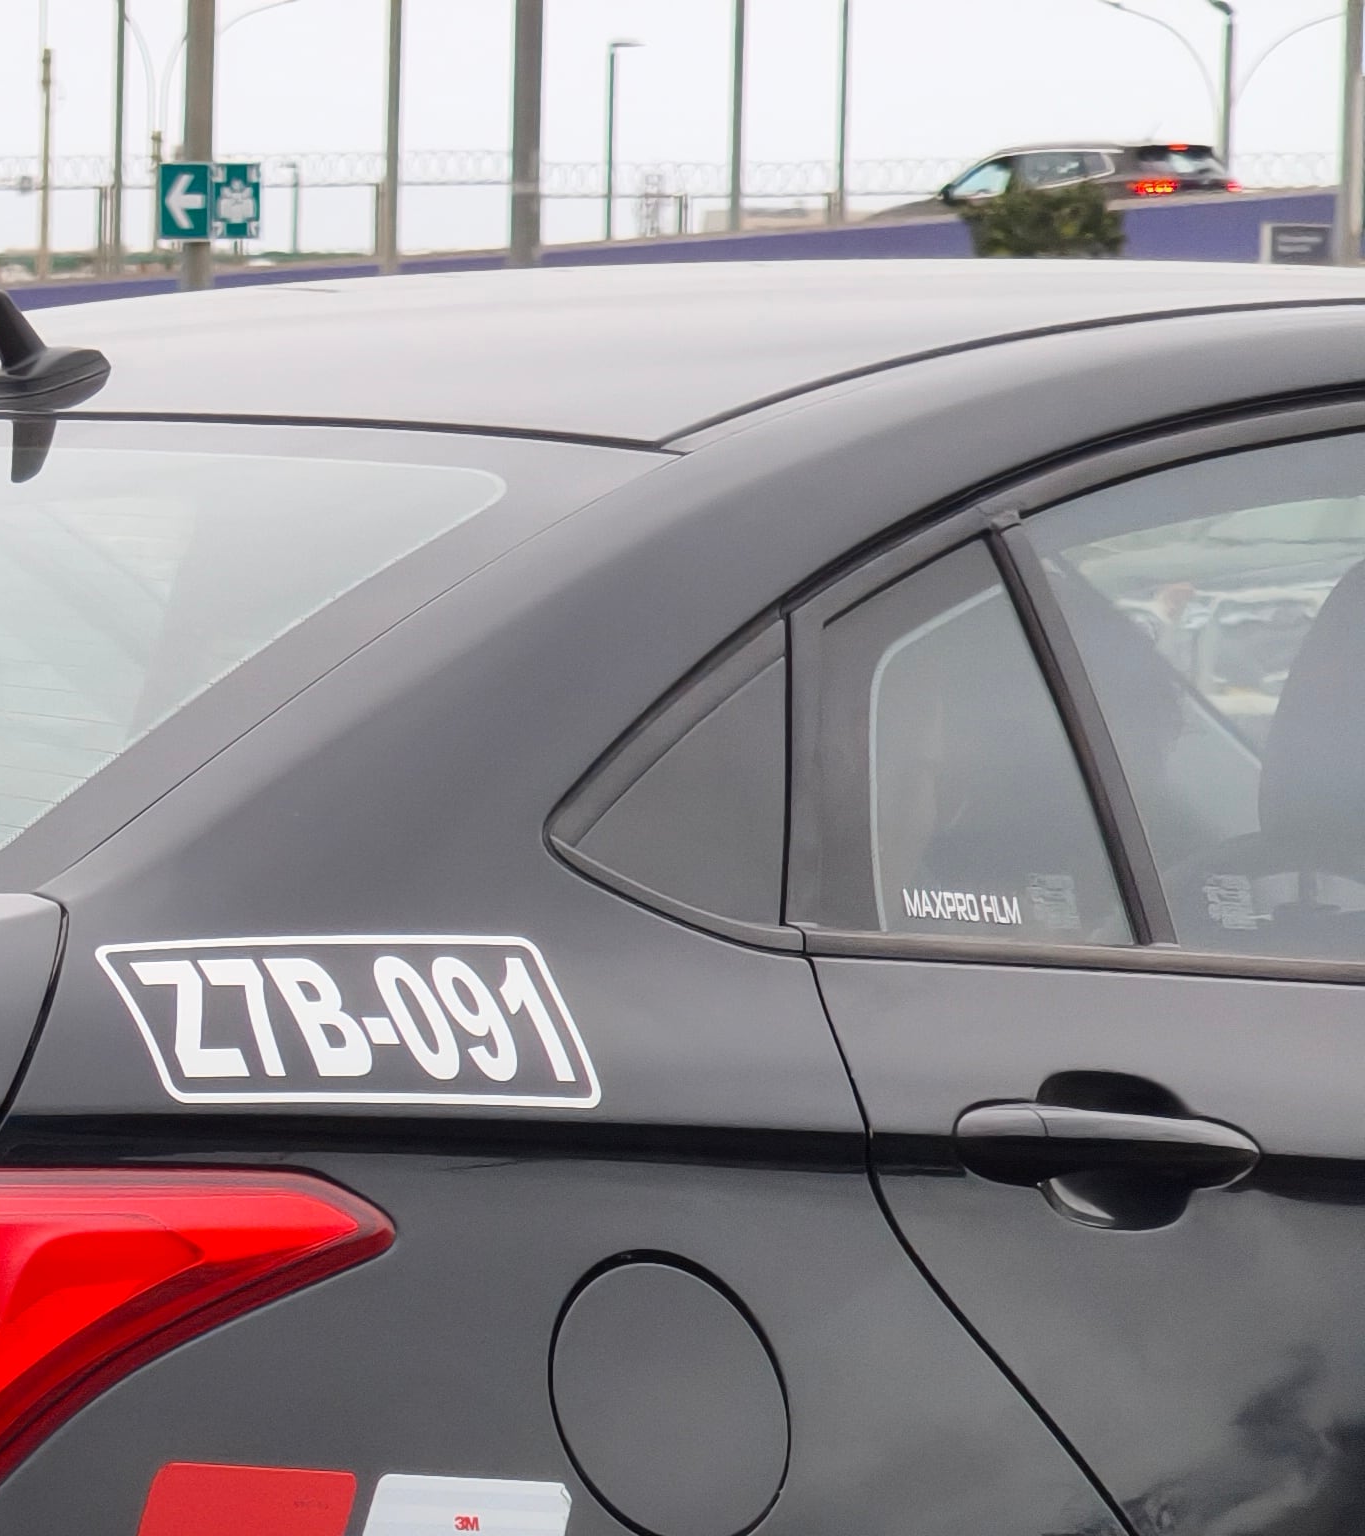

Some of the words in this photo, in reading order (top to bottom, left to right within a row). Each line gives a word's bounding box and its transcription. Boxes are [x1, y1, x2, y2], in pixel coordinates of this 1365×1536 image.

[902, 888, 980, 922] MAXPRO
[981, 894, 1022, 925] FILM
[130, 955, 576, 1083] Z7B-091
[454, 1515, 480, 1532] 3M
